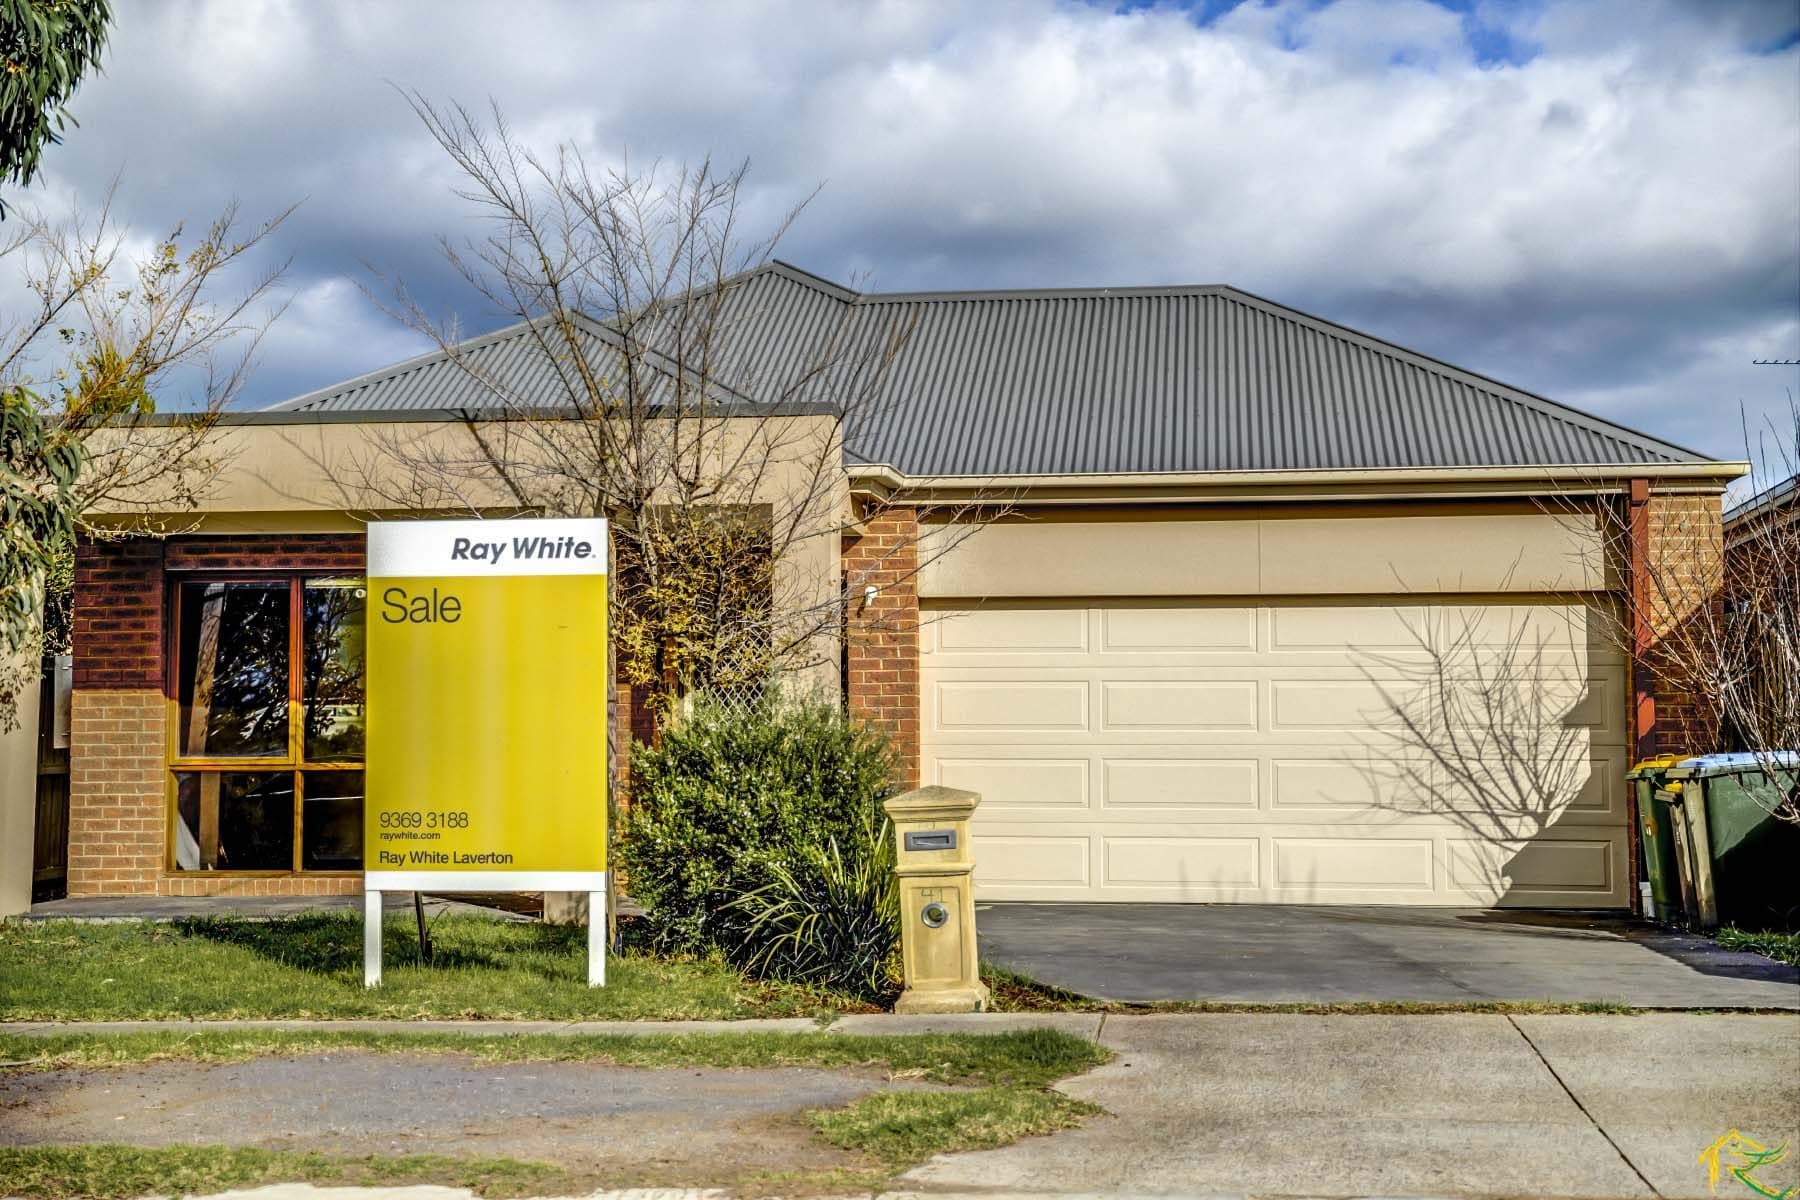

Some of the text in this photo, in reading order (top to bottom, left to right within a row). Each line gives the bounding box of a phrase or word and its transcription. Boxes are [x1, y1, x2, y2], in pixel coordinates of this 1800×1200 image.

[451, 537, 507, 565] Ray
[382, 587, 462, 623] Sale
[380, 811, 469, 829] 9369 3188
[380, 831, 441, 841] raywhite.com
[379, 850, 513, 866] Ray White Laverton
